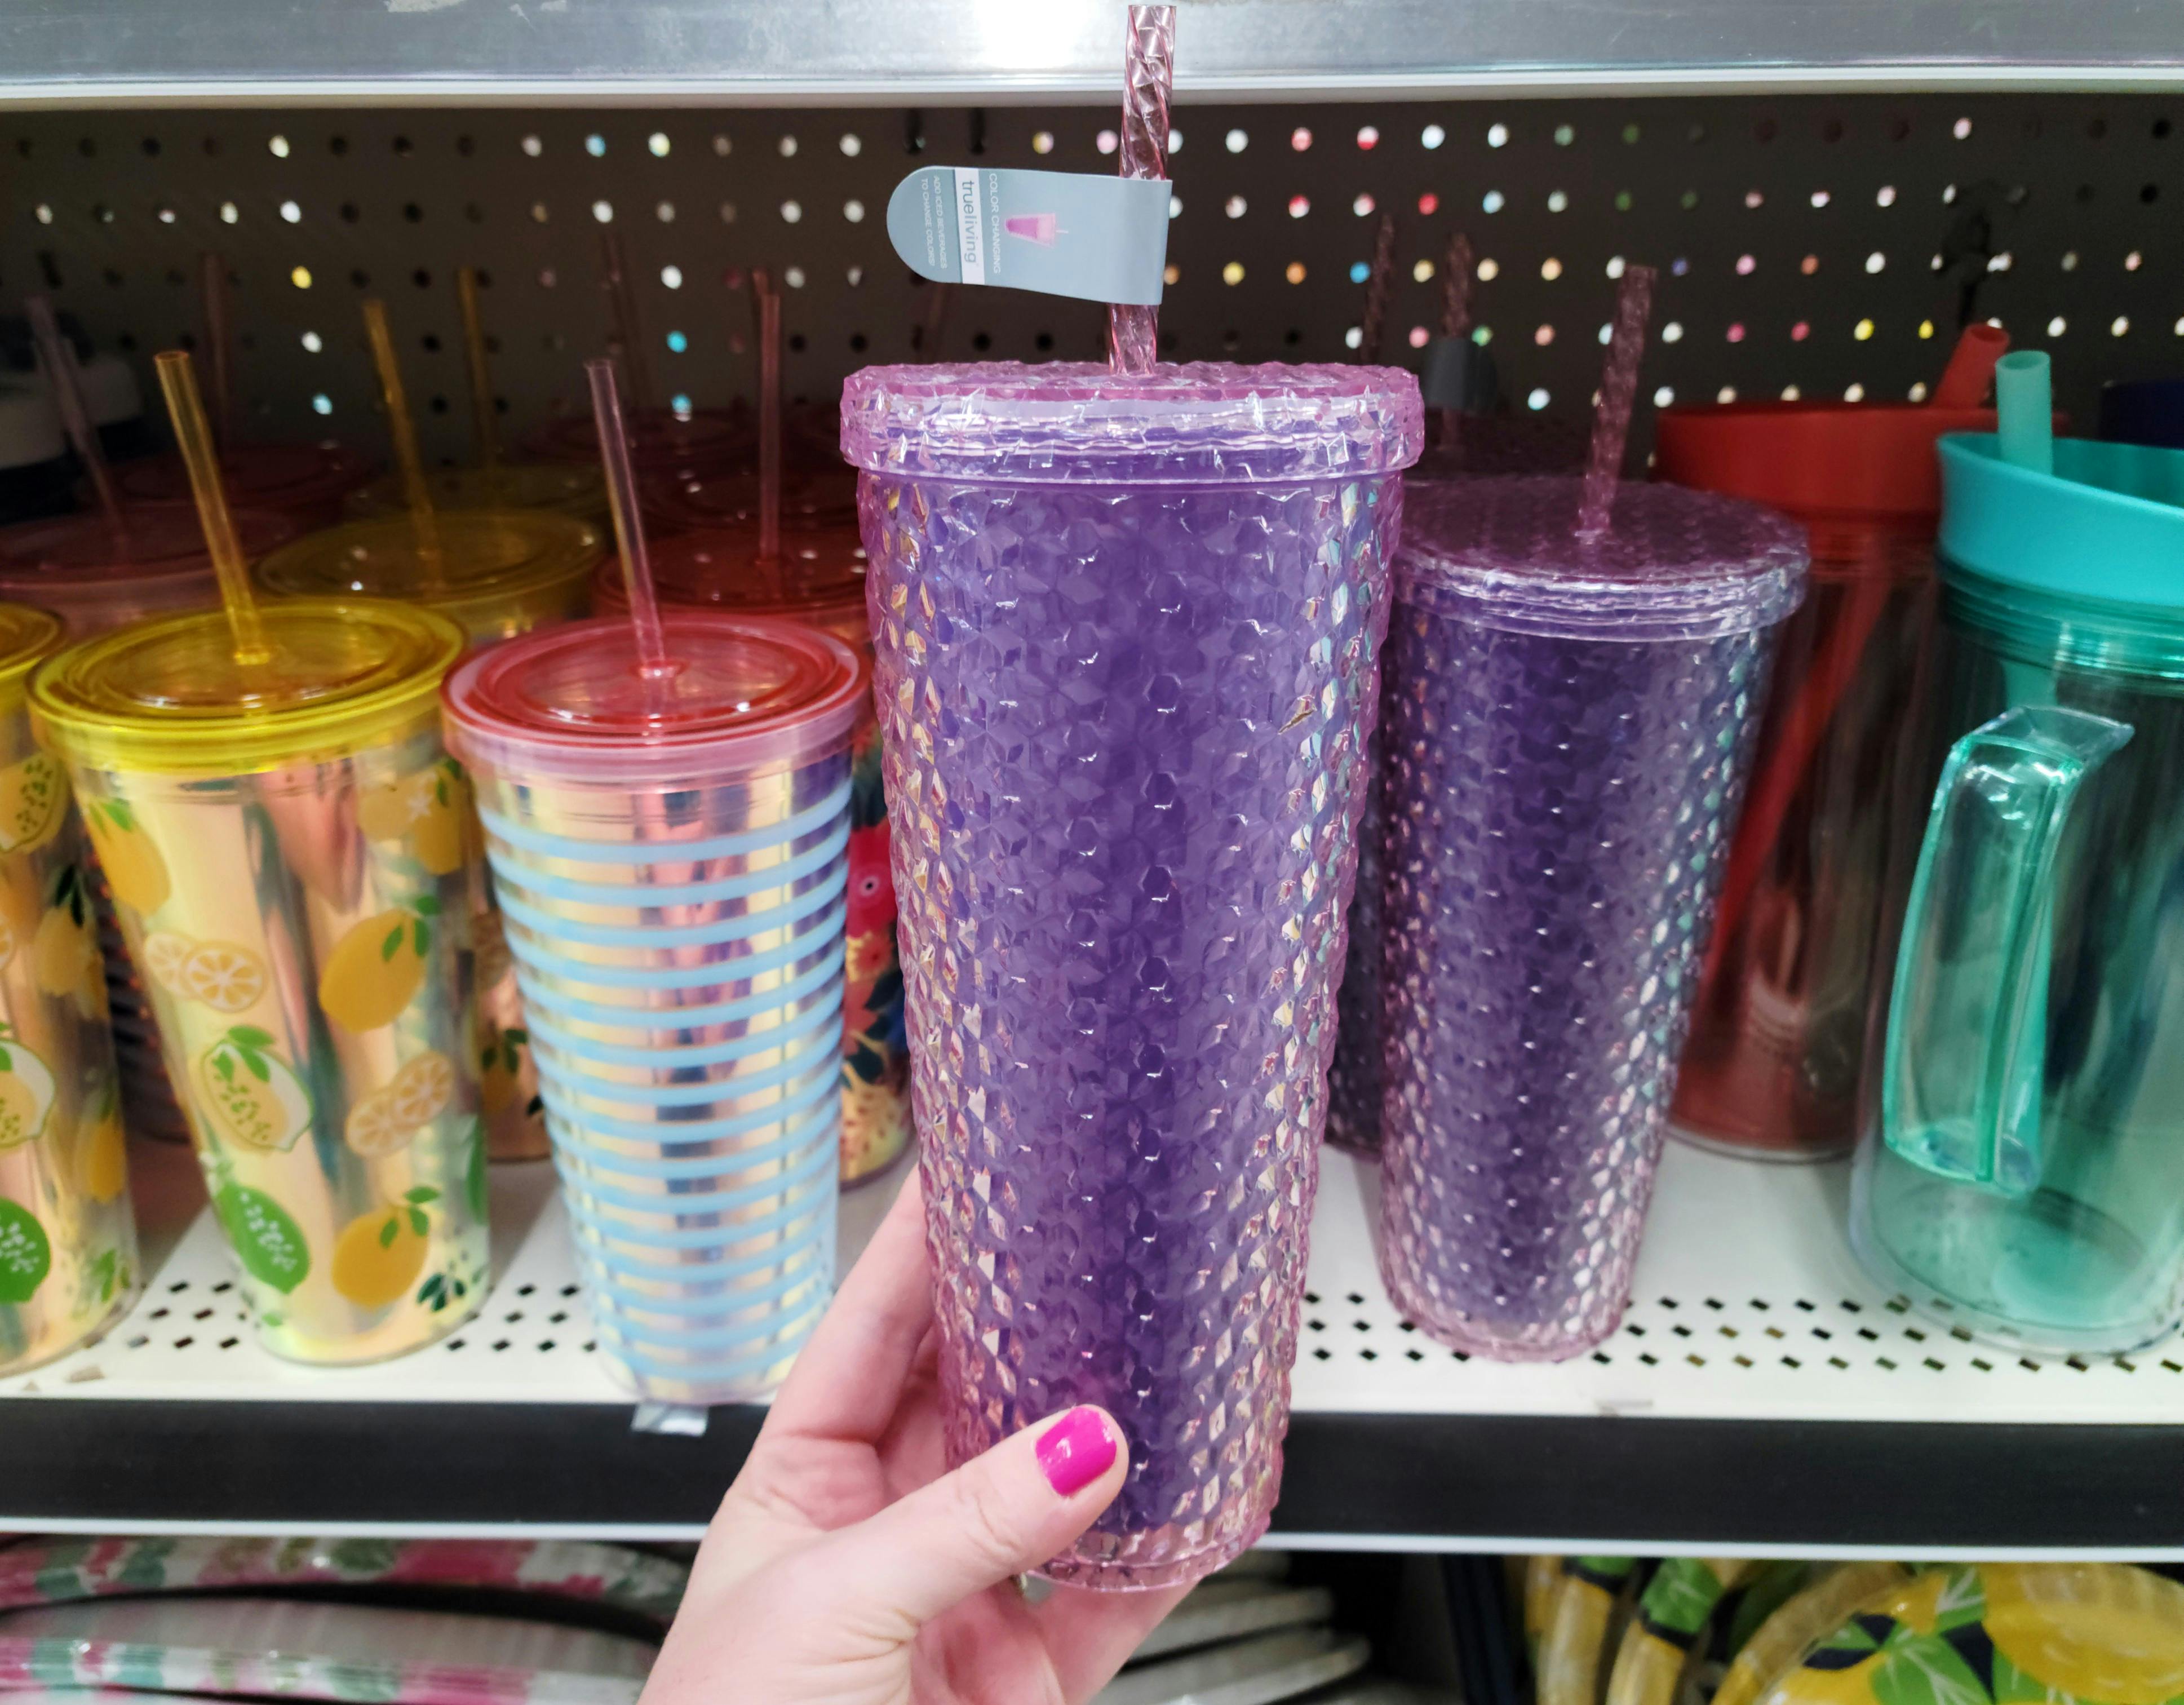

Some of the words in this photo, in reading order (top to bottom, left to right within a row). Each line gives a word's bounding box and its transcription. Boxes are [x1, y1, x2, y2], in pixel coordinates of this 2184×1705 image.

[921, 178, 928, 191] TO
[989, 173, 999, 212] COLOR
[923, 192, 932, 228] CHANGE
[962, 180, 977, 263] trueliving
[937, 218, 947, 269] BEVERAGES
[991, 215, 1001, 274] CHANGING
